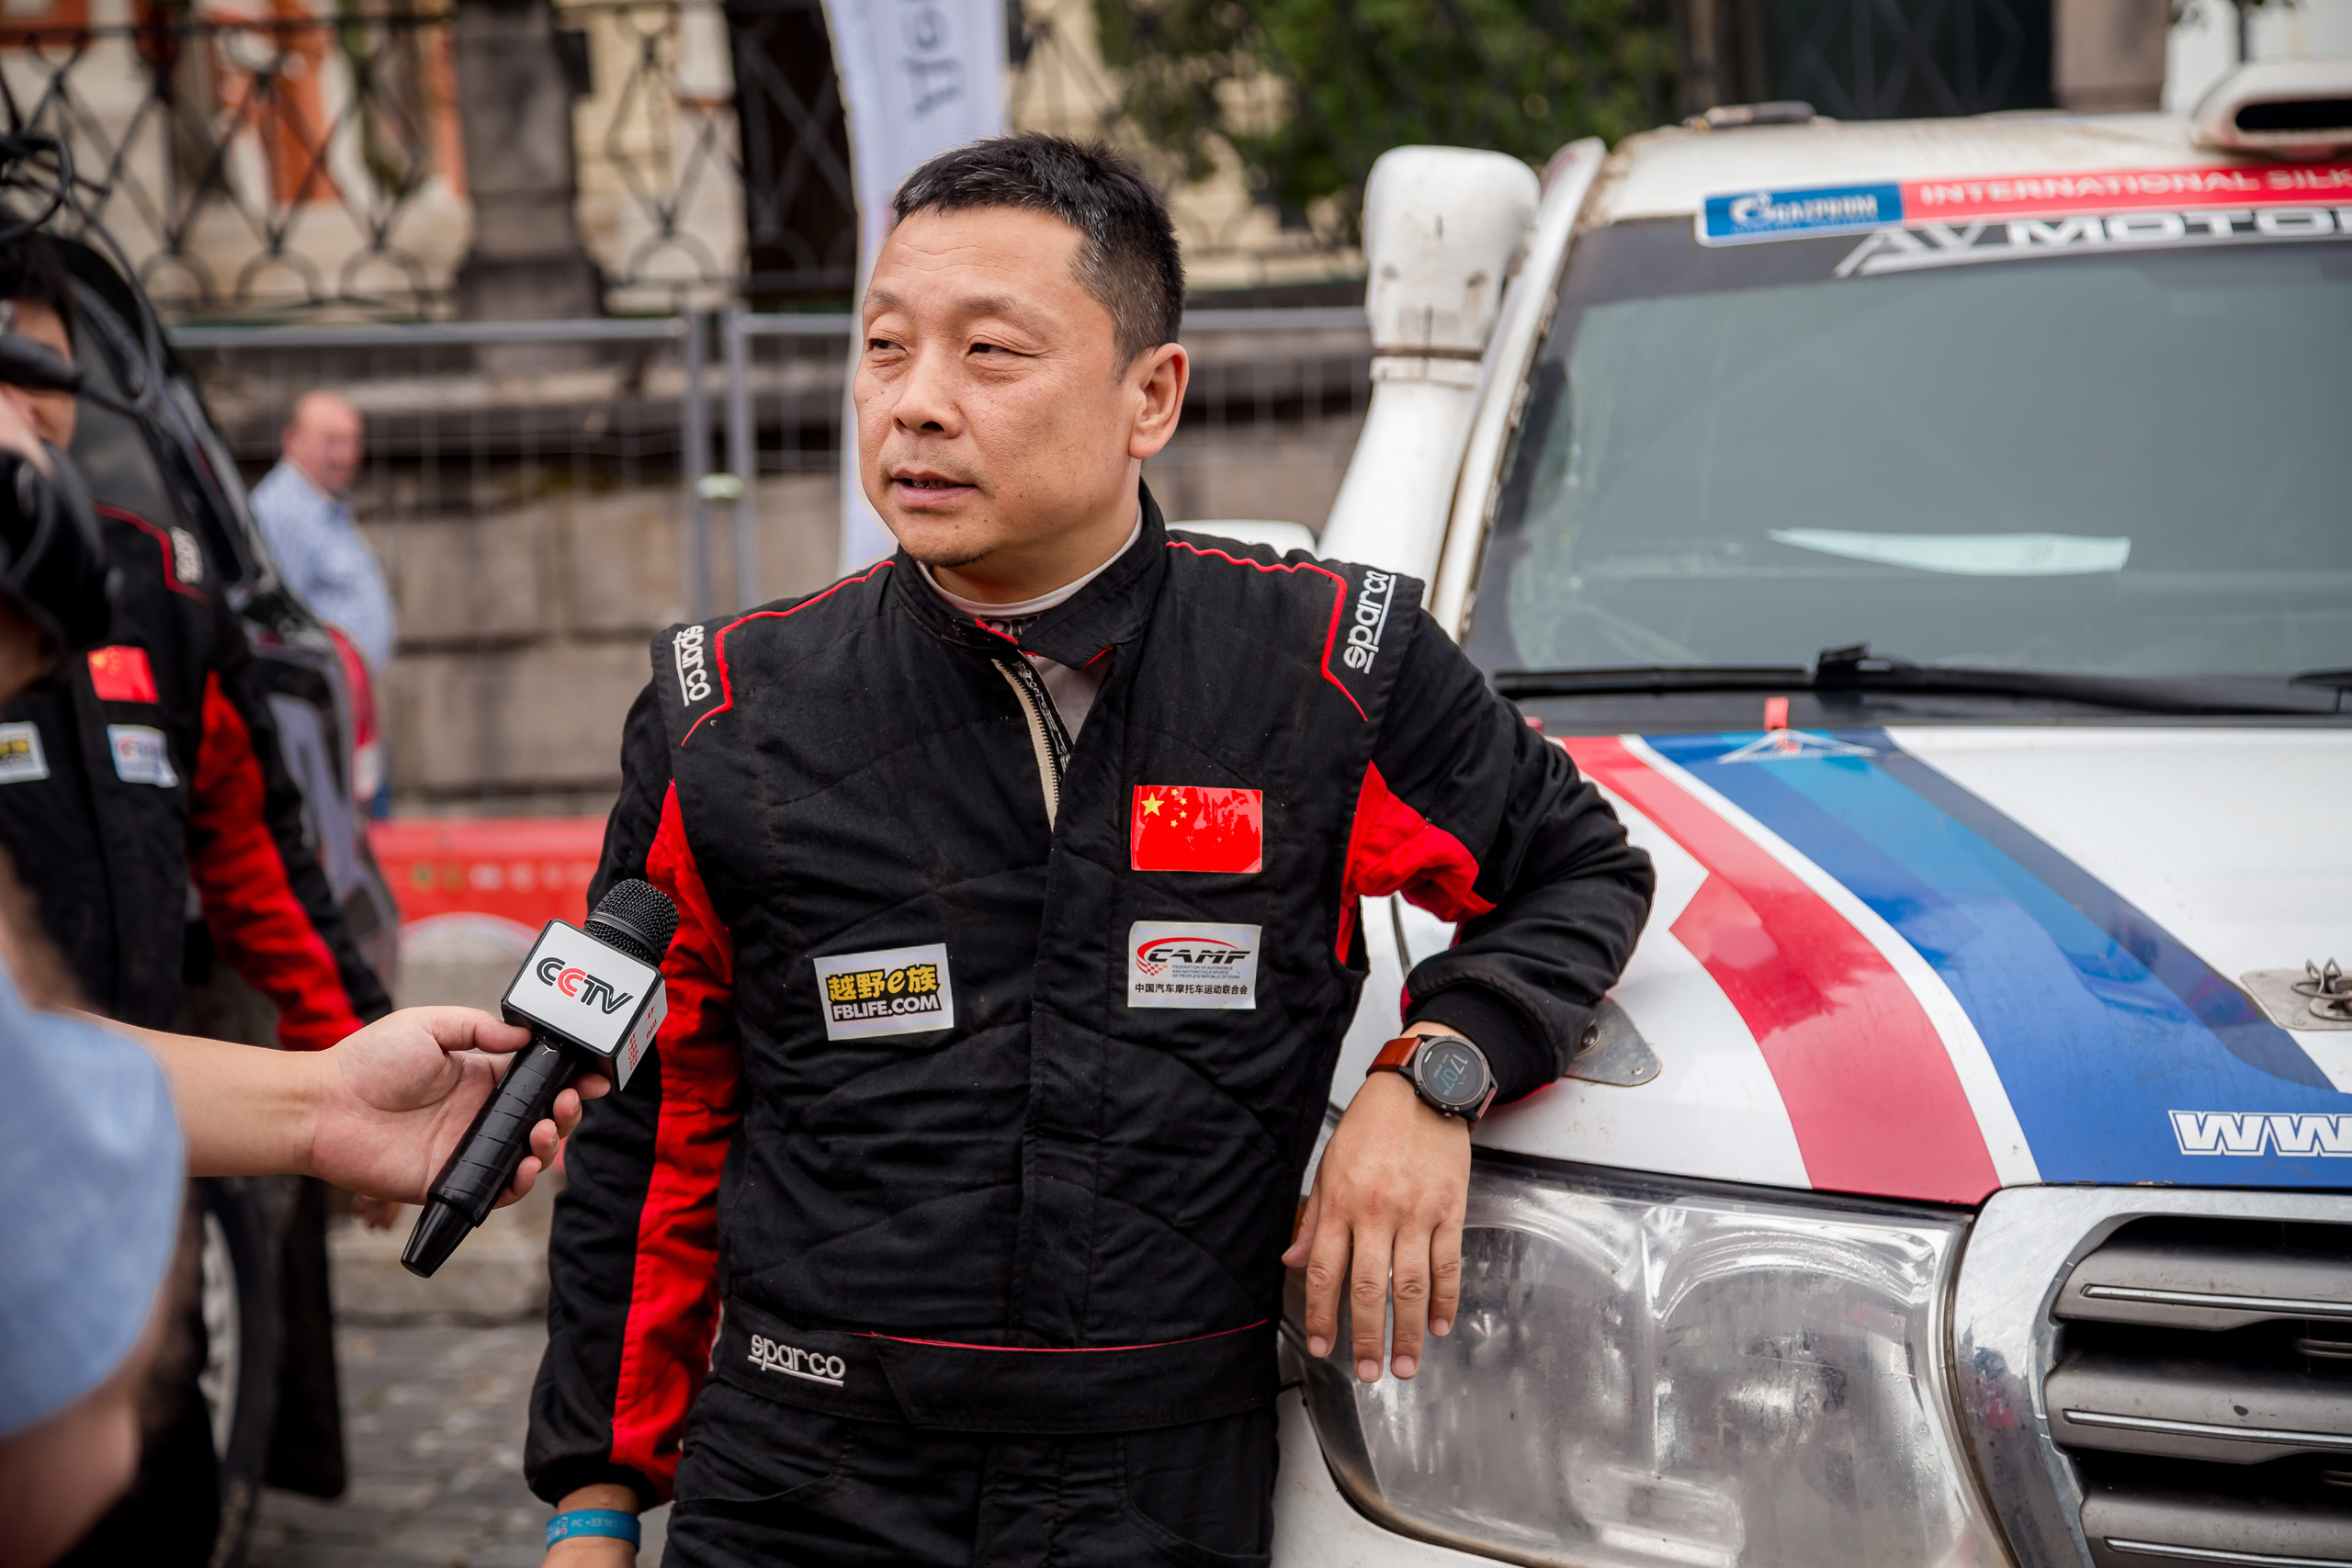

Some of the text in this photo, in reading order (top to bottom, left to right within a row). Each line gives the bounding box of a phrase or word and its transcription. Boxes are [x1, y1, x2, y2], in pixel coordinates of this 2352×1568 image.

[1918, 170, 2259, 207] INTERNATIONAL
[1343, 570, 1395, 672] sparco
[673, 625, 712, 705] sparco
[1148, 949, 1251, 964] CAMF
[537, 956, 635, 1015] CCTV
[827, 964, 939, 1001] 越野e族
[1136, 983, 1248, 995] 中国汽车摩托车运动联合会
[832, 995, 940, 1021] FBLIFE.COM
[749, 1334, 846, 1384] sparco
